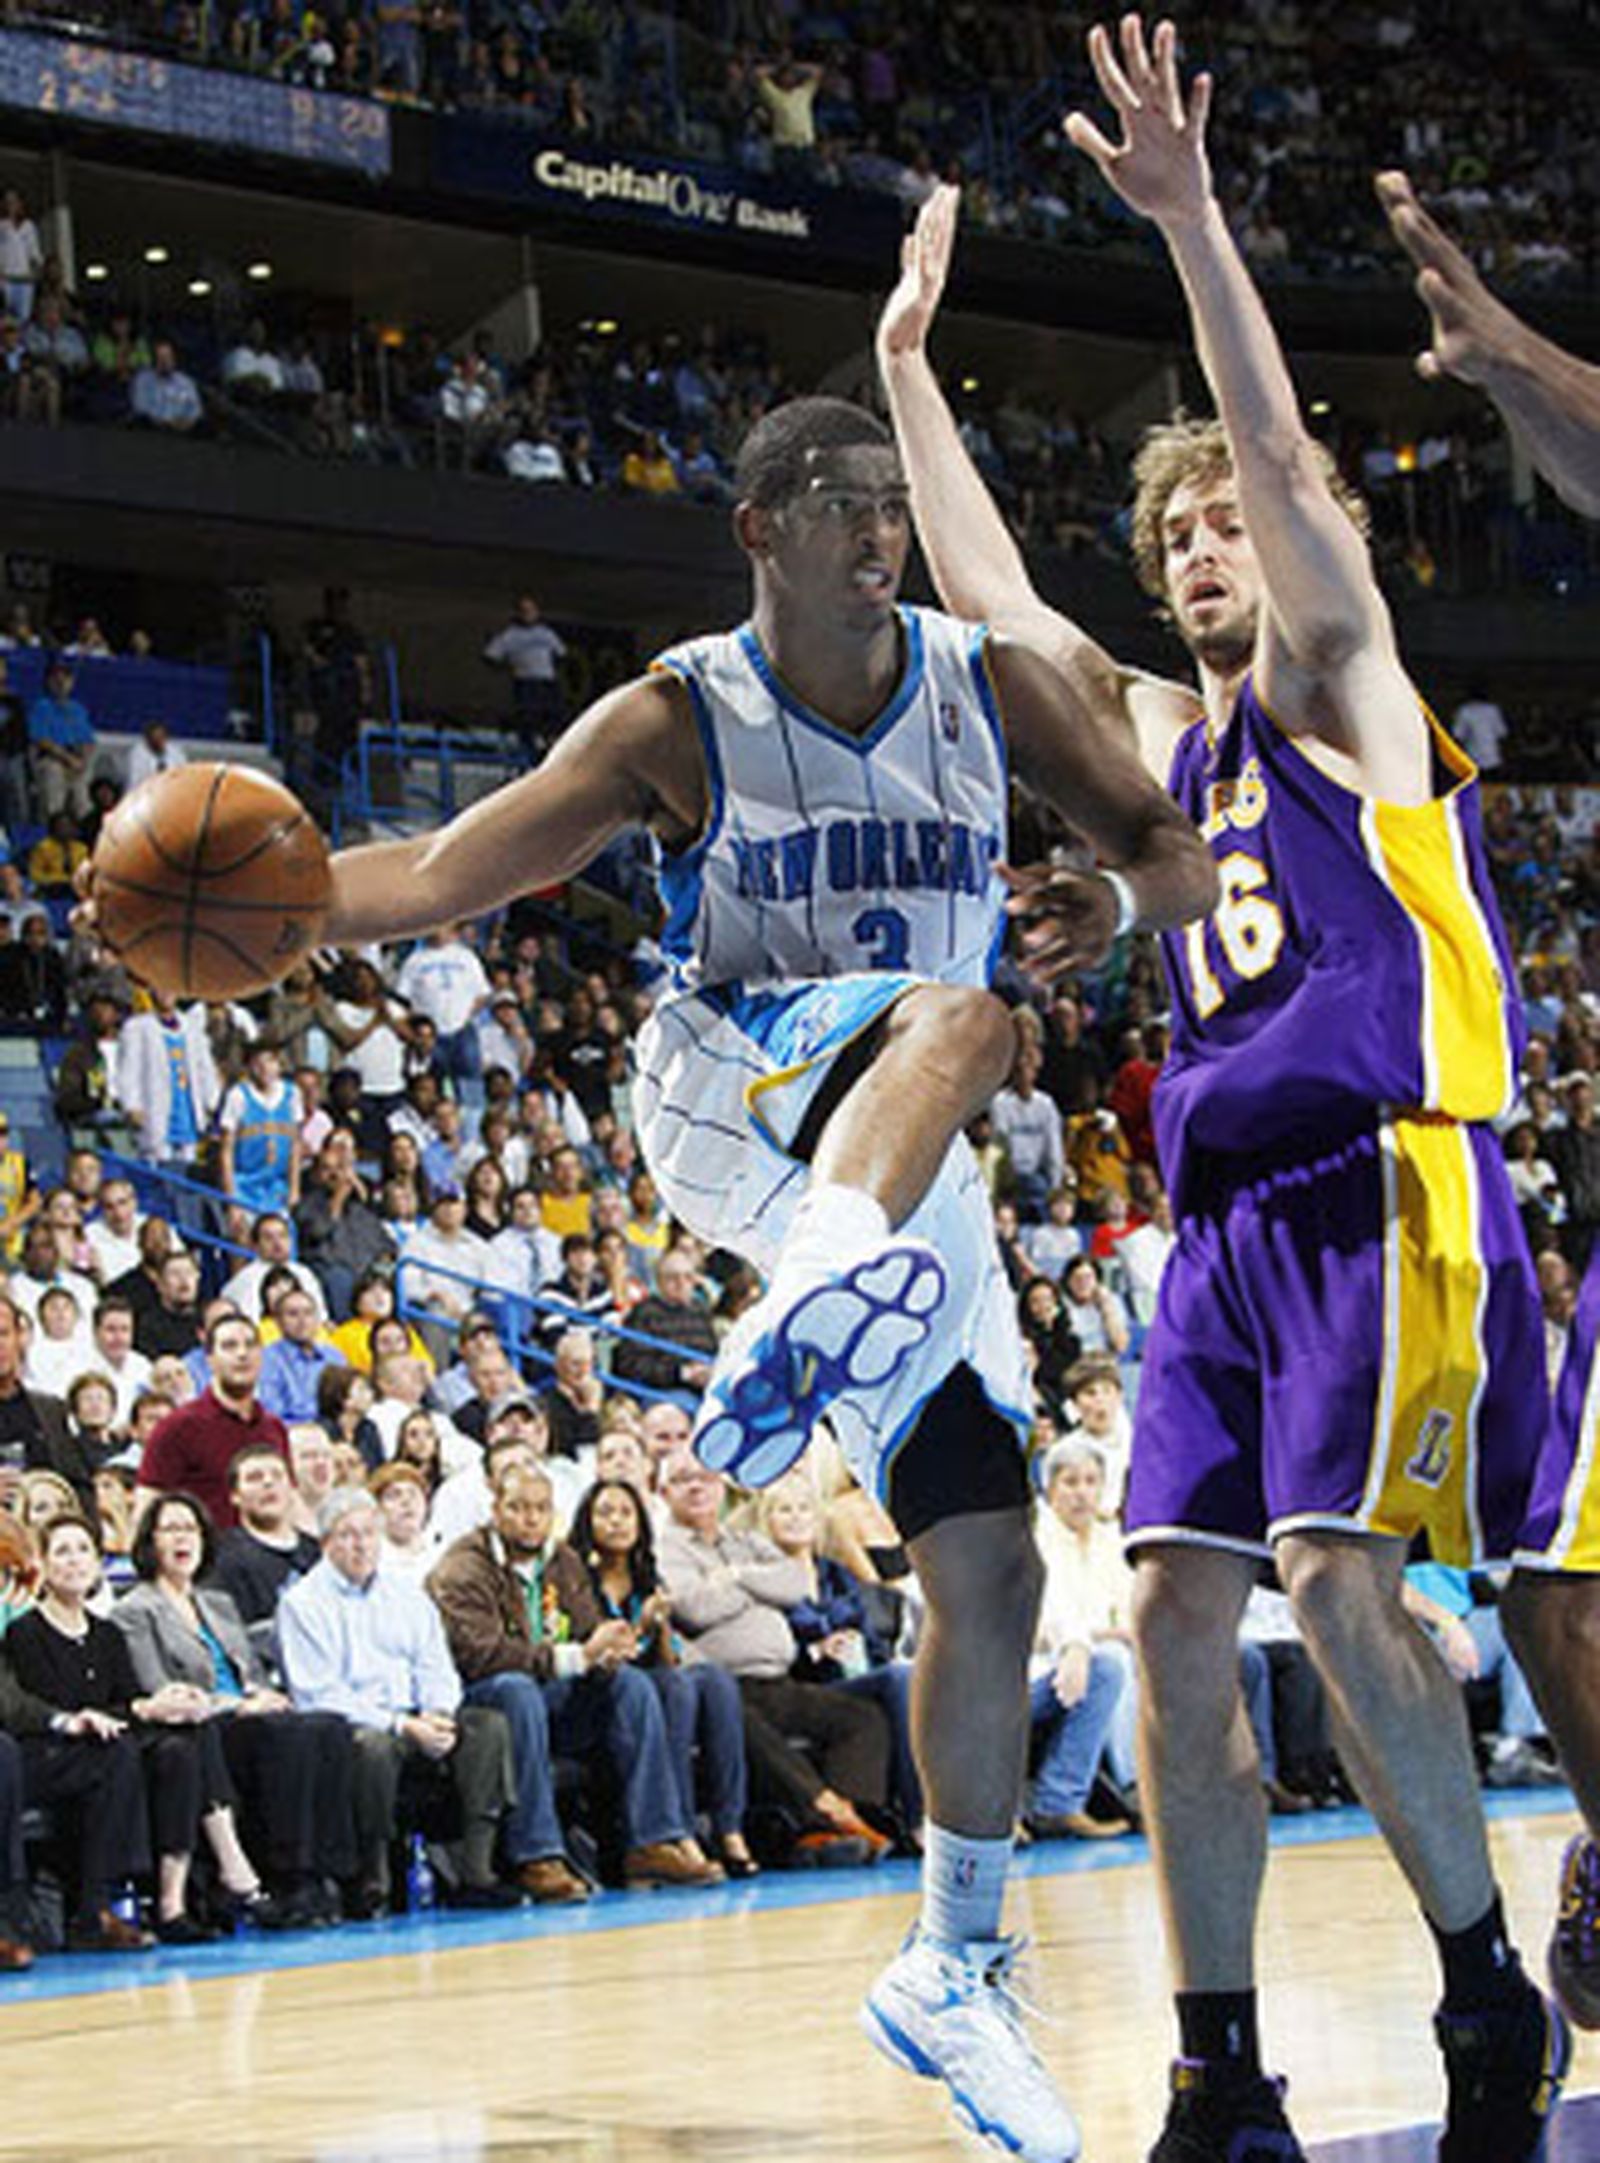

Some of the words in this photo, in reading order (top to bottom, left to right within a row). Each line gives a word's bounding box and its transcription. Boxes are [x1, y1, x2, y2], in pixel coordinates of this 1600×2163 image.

[736, 198, 809, 236] Bank
[852, 908, 910, 970] 3
[1183, 850, 1285, 1020] 16
